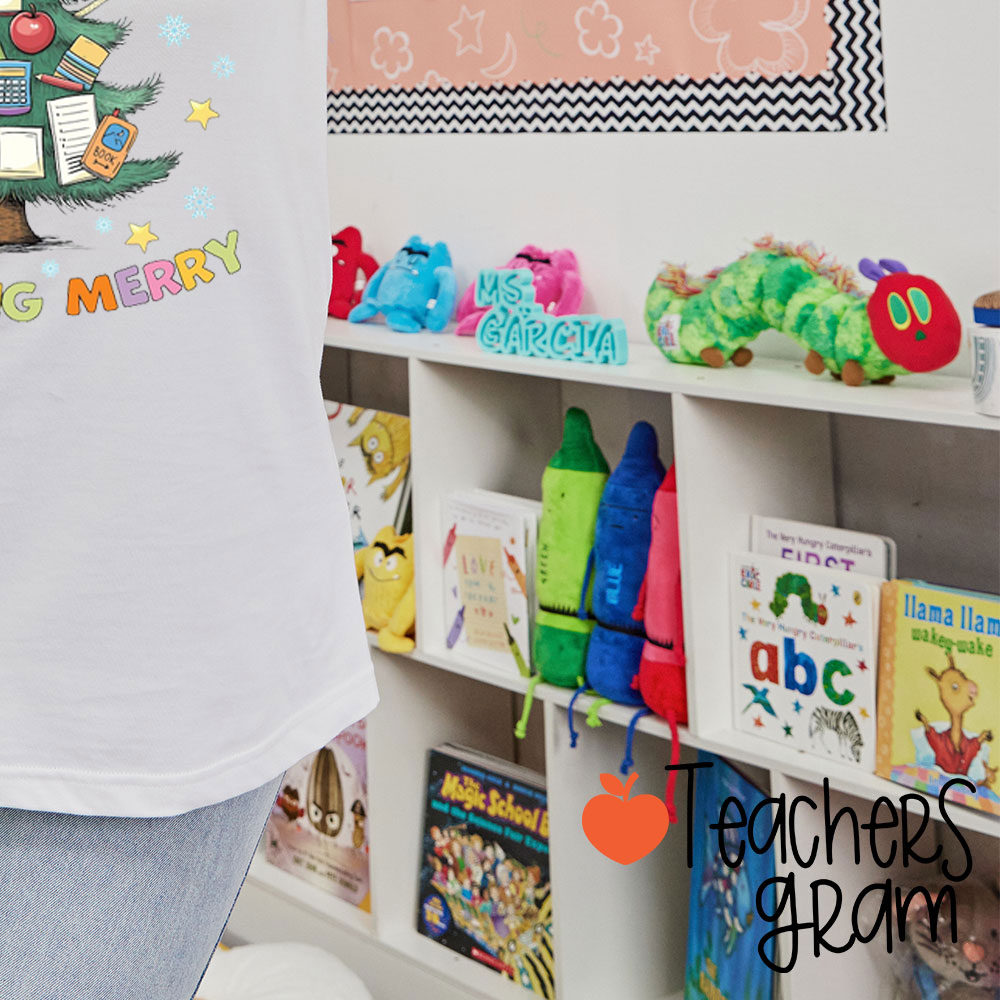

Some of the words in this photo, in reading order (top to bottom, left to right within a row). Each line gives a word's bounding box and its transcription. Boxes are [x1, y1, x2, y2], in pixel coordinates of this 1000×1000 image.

[93, 145, 118, 166] BOOK
[66, 230, 242, 316] MERRY
[477, 311, 622, 365] GARCIA
[904, 593, 954, 628] llama
[911, 627, 994, 658] wakey-wake
[749, 636, 856, 706] abc
[440, 770, 487, 811] Magic
[486, 788, 540, 833] School
